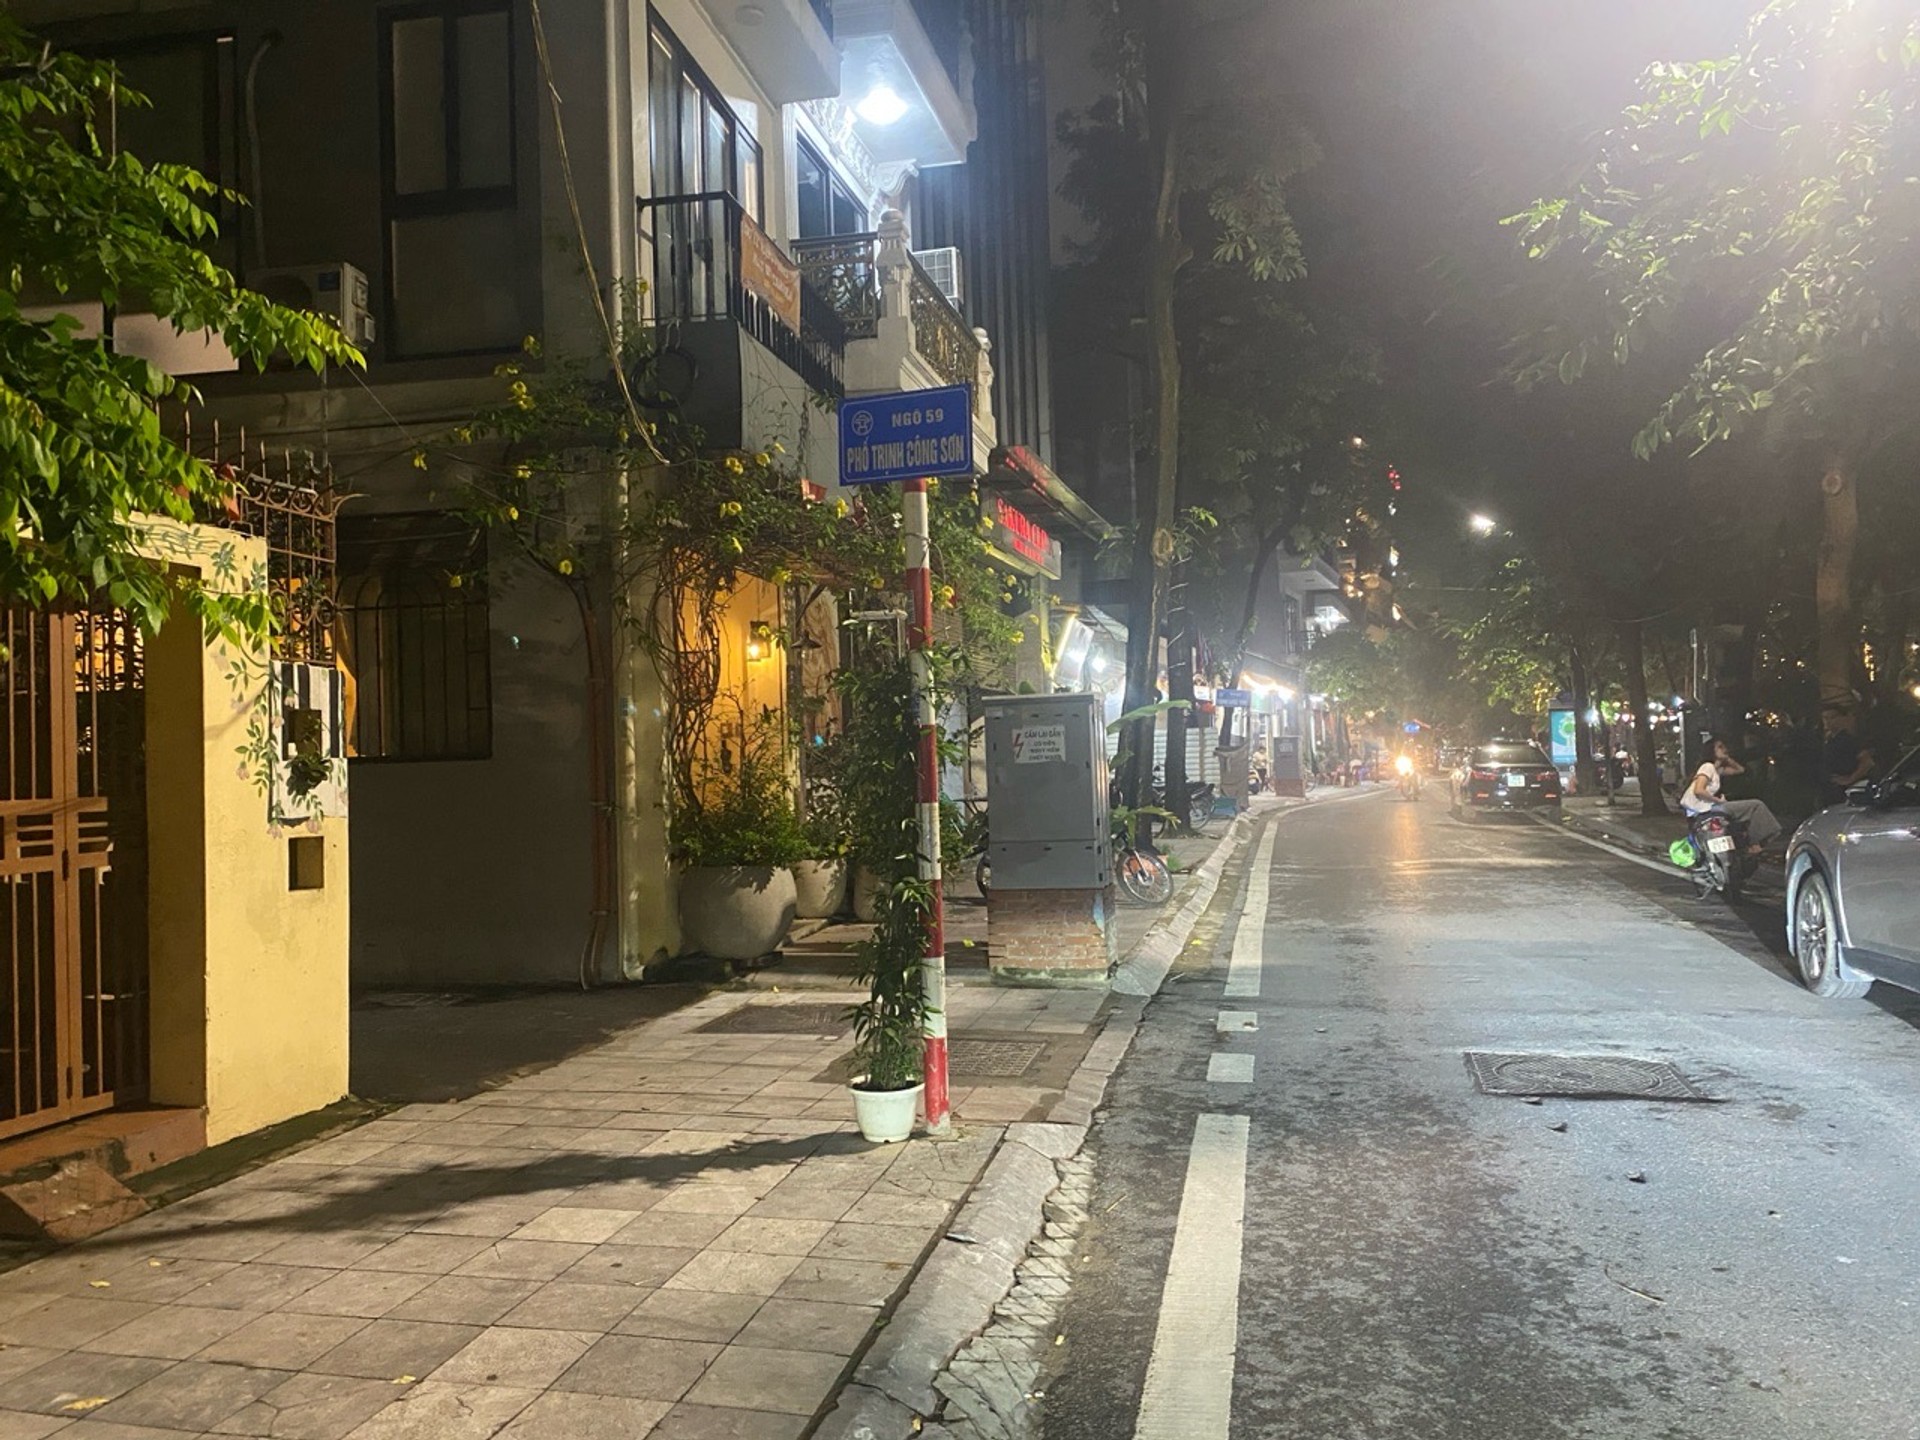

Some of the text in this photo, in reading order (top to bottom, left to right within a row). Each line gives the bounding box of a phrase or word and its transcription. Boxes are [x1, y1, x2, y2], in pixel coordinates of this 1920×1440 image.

[926, 408, 944, 423] 59
[847, 433, 965, 475] PHỐ TRỊNH CÔNG SƠN
